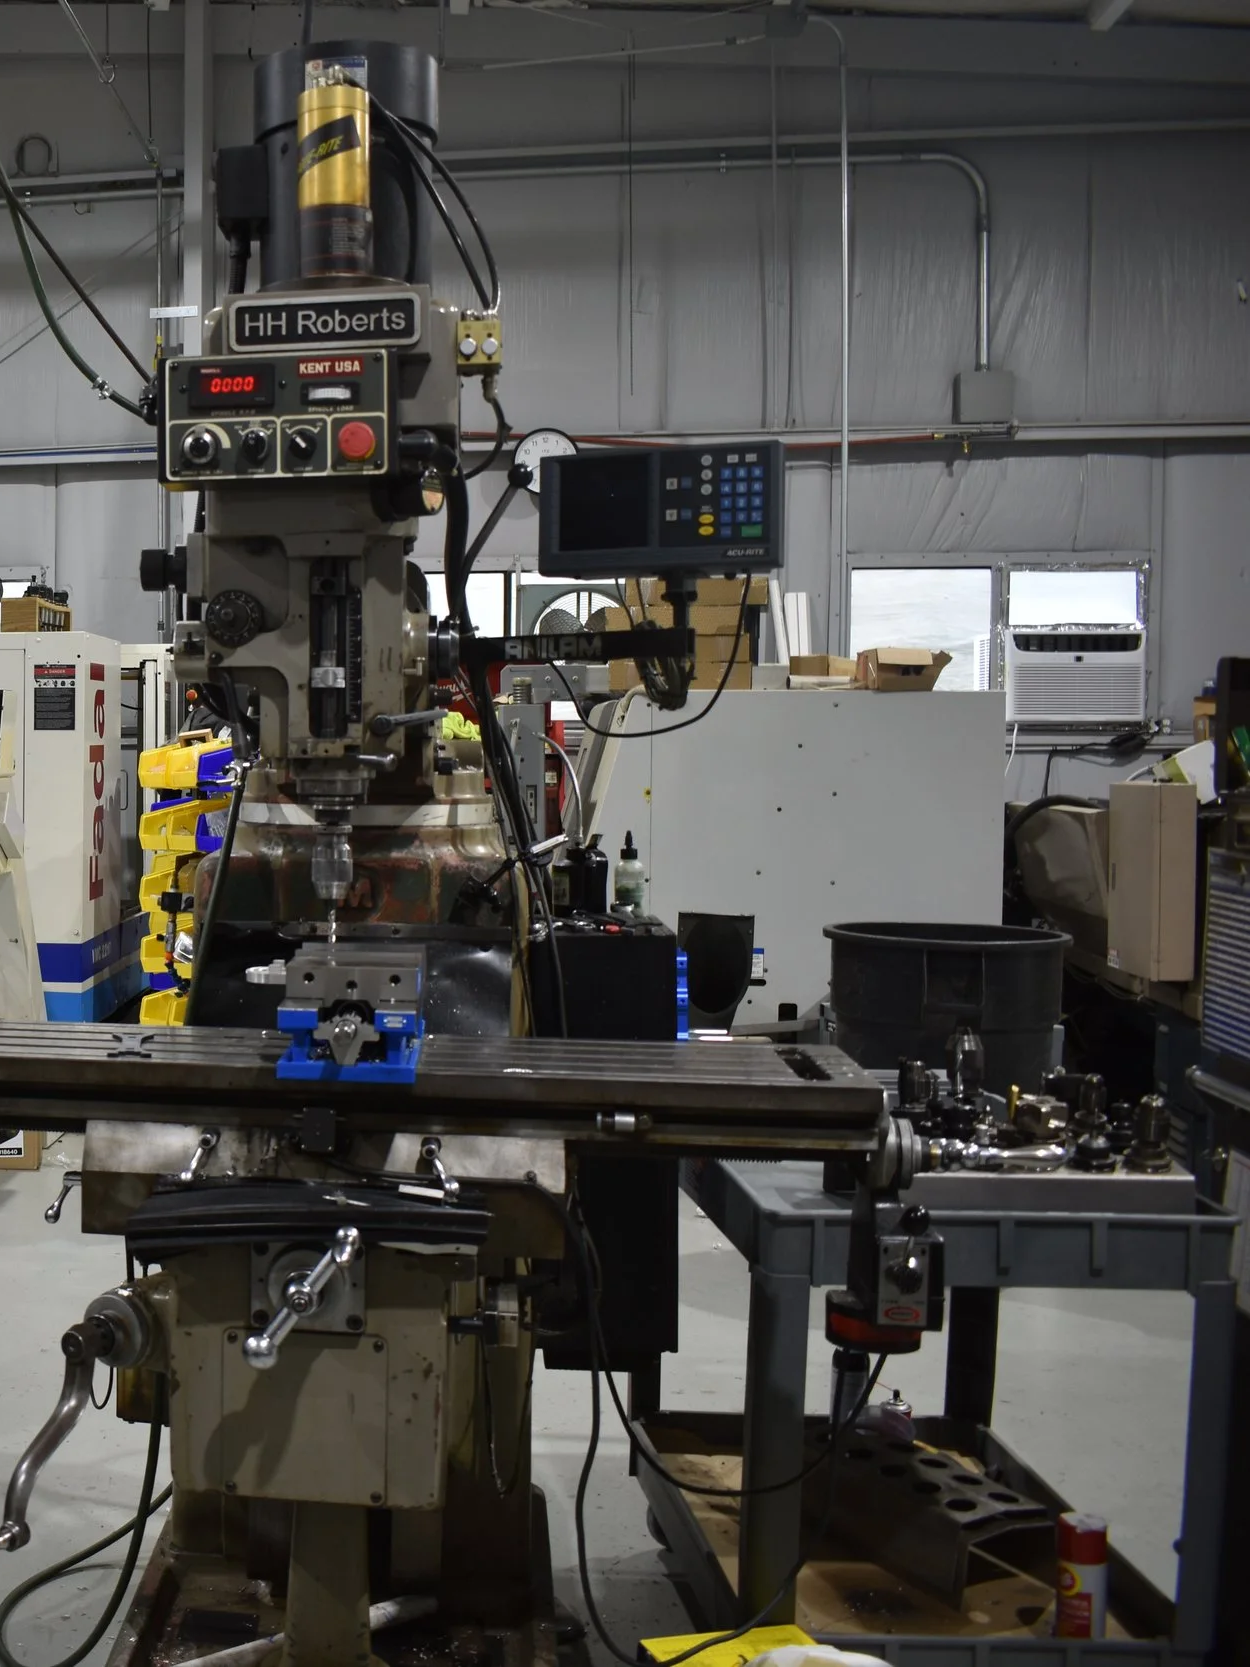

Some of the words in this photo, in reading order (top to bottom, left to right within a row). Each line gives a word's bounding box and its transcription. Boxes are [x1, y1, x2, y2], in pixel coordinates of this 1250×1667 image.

[244, 311, 287, 337] HH
[297, 307, 407, 335] Roberts
[299, 362, 330, 375] KENT
[335, 360, 361, 373] USA
[210, 376, 254, 394] 0000
[726, 548, 764, 557] ACU-RITE
[505, 636, 602, 660] ANILAM
[89, 662, 105, 901] Fadal
